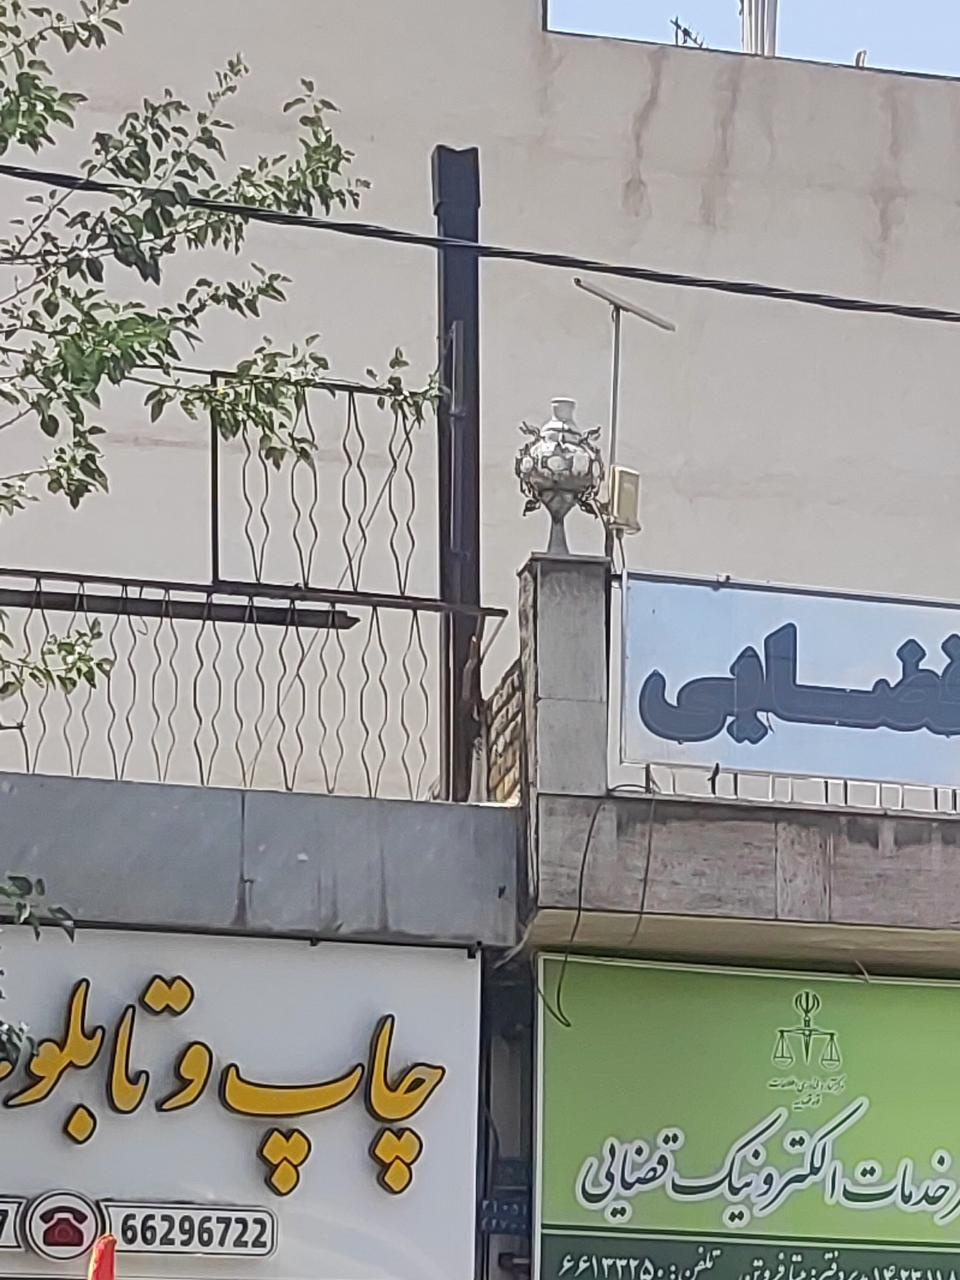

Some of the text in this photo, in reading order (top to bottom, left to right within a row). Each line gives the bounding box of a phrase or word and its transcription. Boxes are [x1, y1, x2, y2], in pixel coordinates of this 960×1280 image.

[0, 974, 446, 1196] چاپ و تابلو
[578, 1131, 680, 1219] قضایی
[670, 1100, 864, 1223] الکترونیک
[841, 1153, 951, 1208] خدمات
[120, 1212, 269, 1250] 66296722
